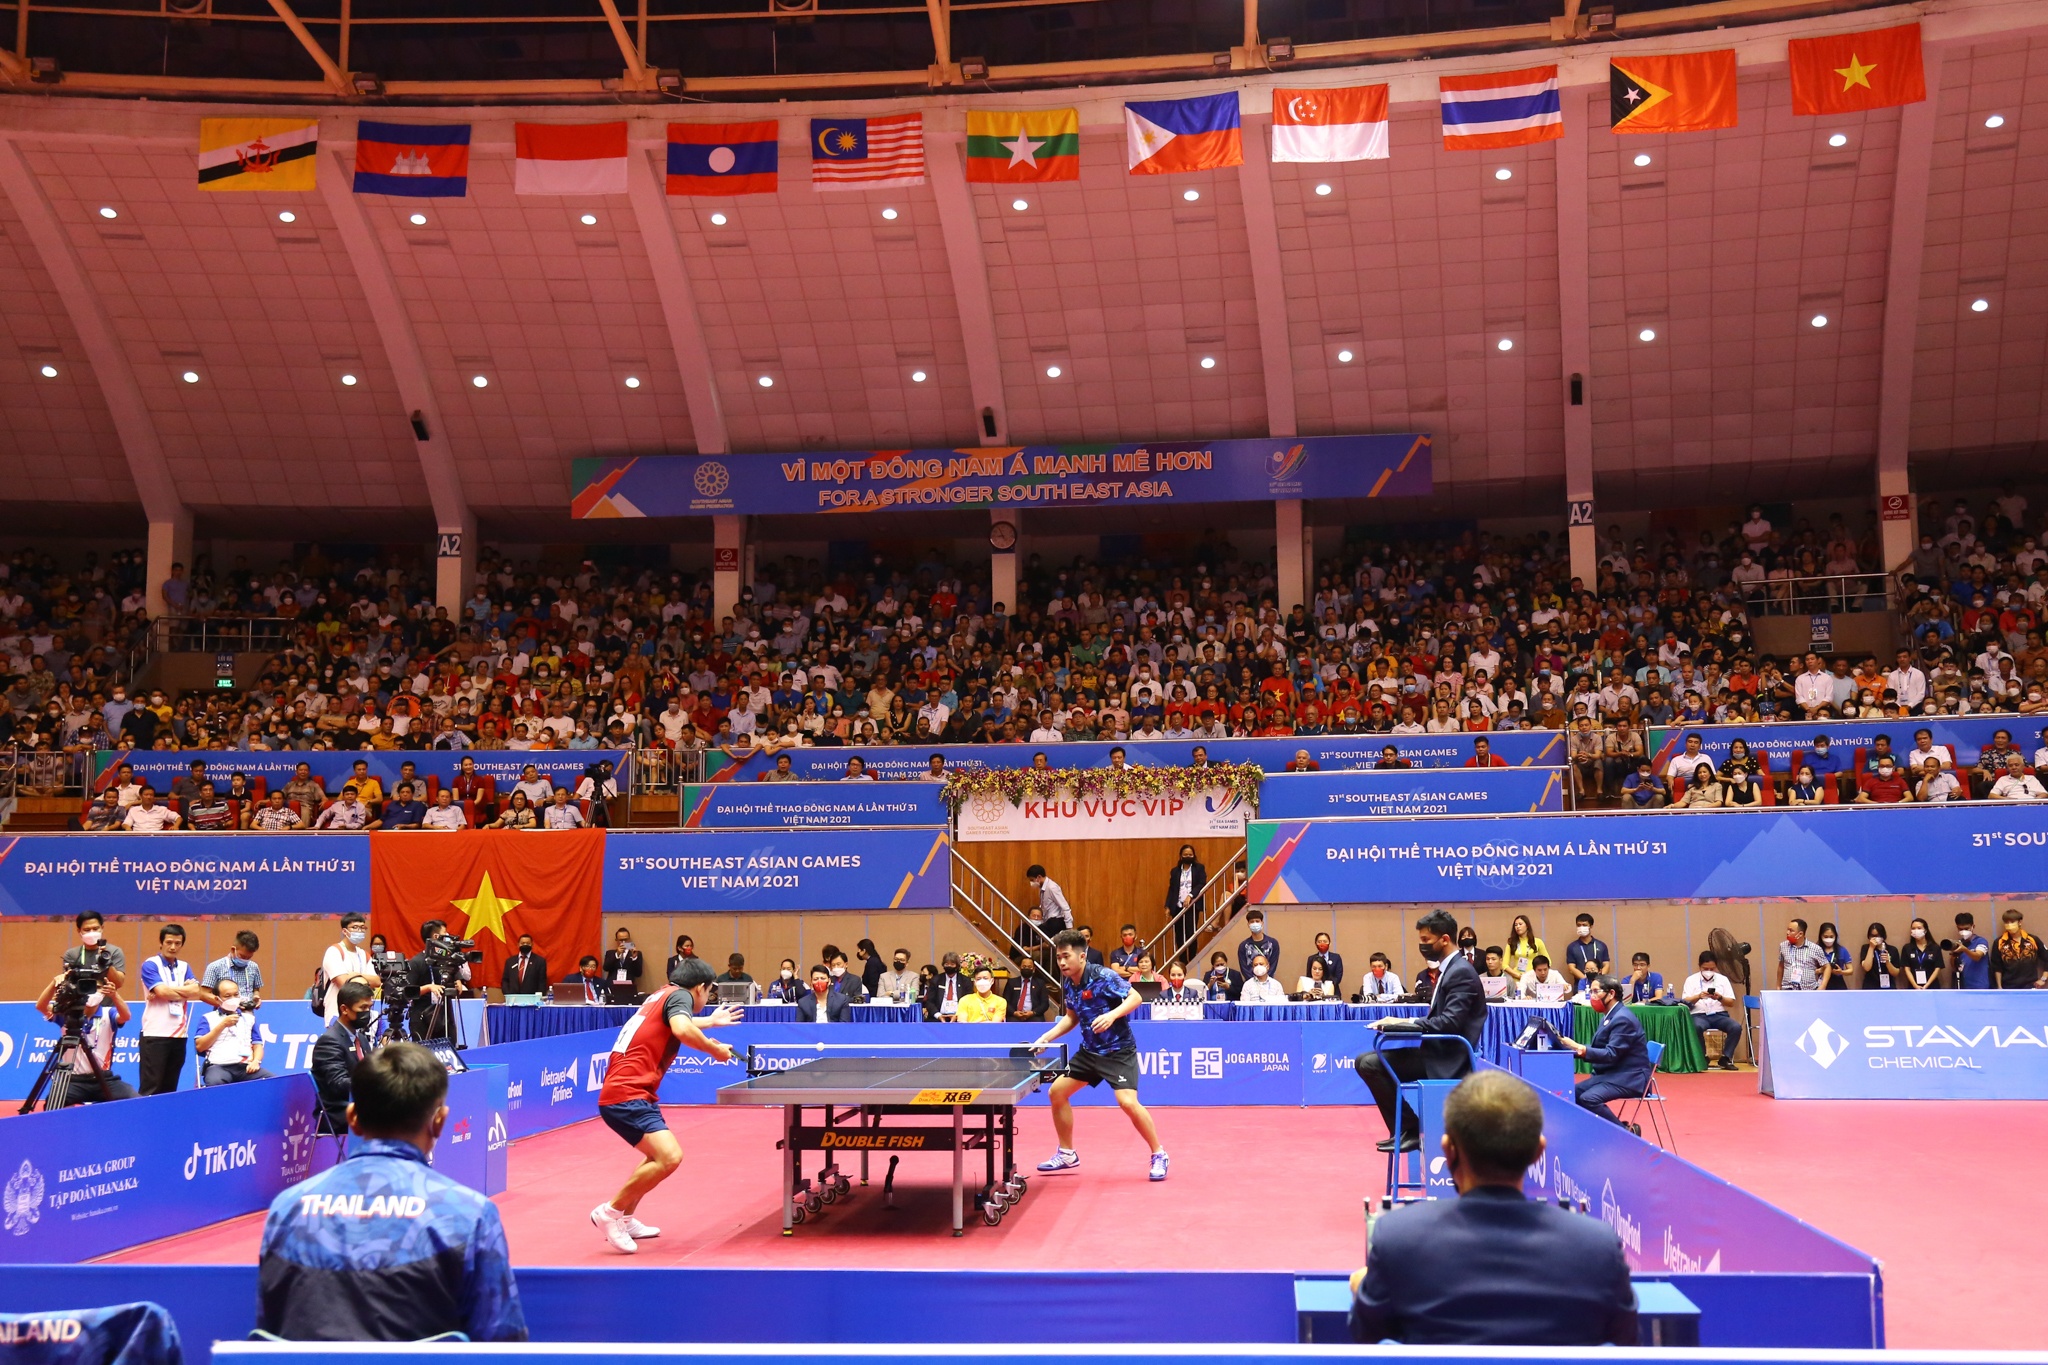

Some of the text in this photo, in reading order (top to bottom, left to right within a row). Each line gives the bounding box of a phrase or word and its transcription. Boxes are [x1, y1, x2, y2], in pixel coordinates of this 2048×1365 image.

[781, 449, 1213, 485] VÌ MỘT ĐÔNG NAM Á MẠNH MẼ HƠN
[818, 481, 1174, 507] FOR A STRONGER SOUTH EAST ASIA
[1570, 502, 1593, 525] A2
[439, 535, 461, 555] A2
[1767, 739, 1792, 748] ĐÔNG
[1794, 739, 1815, 748] NAM
[1864, 737, 1873, 745] 31
[1423, 749, 1458, 757] GAMES
[1769, 751, 1790, 759] NAM
[473, 763, 521, 771] OUTHEAST
[552, 762, 584, 771] GAMES
[885, 760, 909, 769] ĐÔNG
[886, 771, 906, 779] NAM
[1345, 793, 1411, 802] SOUTHEAST
[1412, 792, 1446, 801] ASIAN
[1448, 791, 1488, 801] GAMES
[717, 799, 917, 815] ĐẠI HỘI THỂ THAO ĐÔNG NAM Á LẦN THỨ 31
[1025, 800, 1078, 819] KHU
[1142, 798, 1184, 816] VIP
[1369, 804, 1448, 815] VIET NAM 2021
[783, 814, 851, 826] VIỆT NAM 2021
[1972, 831, 2048, 847] 31st SOU
[1326, 839, 1668, 862] ĐẠI HỘI THỂ THAO ĐÔNG NAM Á LẦN THỨ 31
[24, 856, 356, 876] ĐẠI HỘI THỂ THAO ĐÔNG NAM Á LẦN THỨ 31
[619, 855, 861, 870] 31st SOUTHEAST ASIAN GAMES
[1437, 863, 1553, 880] VIỆT NAM 2021
[135, 877, 248, 894] VIỆT NAM 2021
[681, 875, 800, 889] VIET NAM 2021
[1863, 1025, 2048, 1048] STAVIA
[1136, 1048, 1182, 1079] VIỆT
[1225, 1052, 1289, 1064] JOGARBOLA
[1868, 1056, 1982, 1069] CHEMICAL
[1262, 1063, 1290, 1073] JAPAN
[820, 1131, 925, 1148] DOUBLE FISH
[203, 1139, 258, 1176] TikTok
[59, 1155, 136, 1184] HANAKA GROUP
[97, 1177, 140, 1198] HANAKA
[300, 1193, 426, 1219] THAILAND
